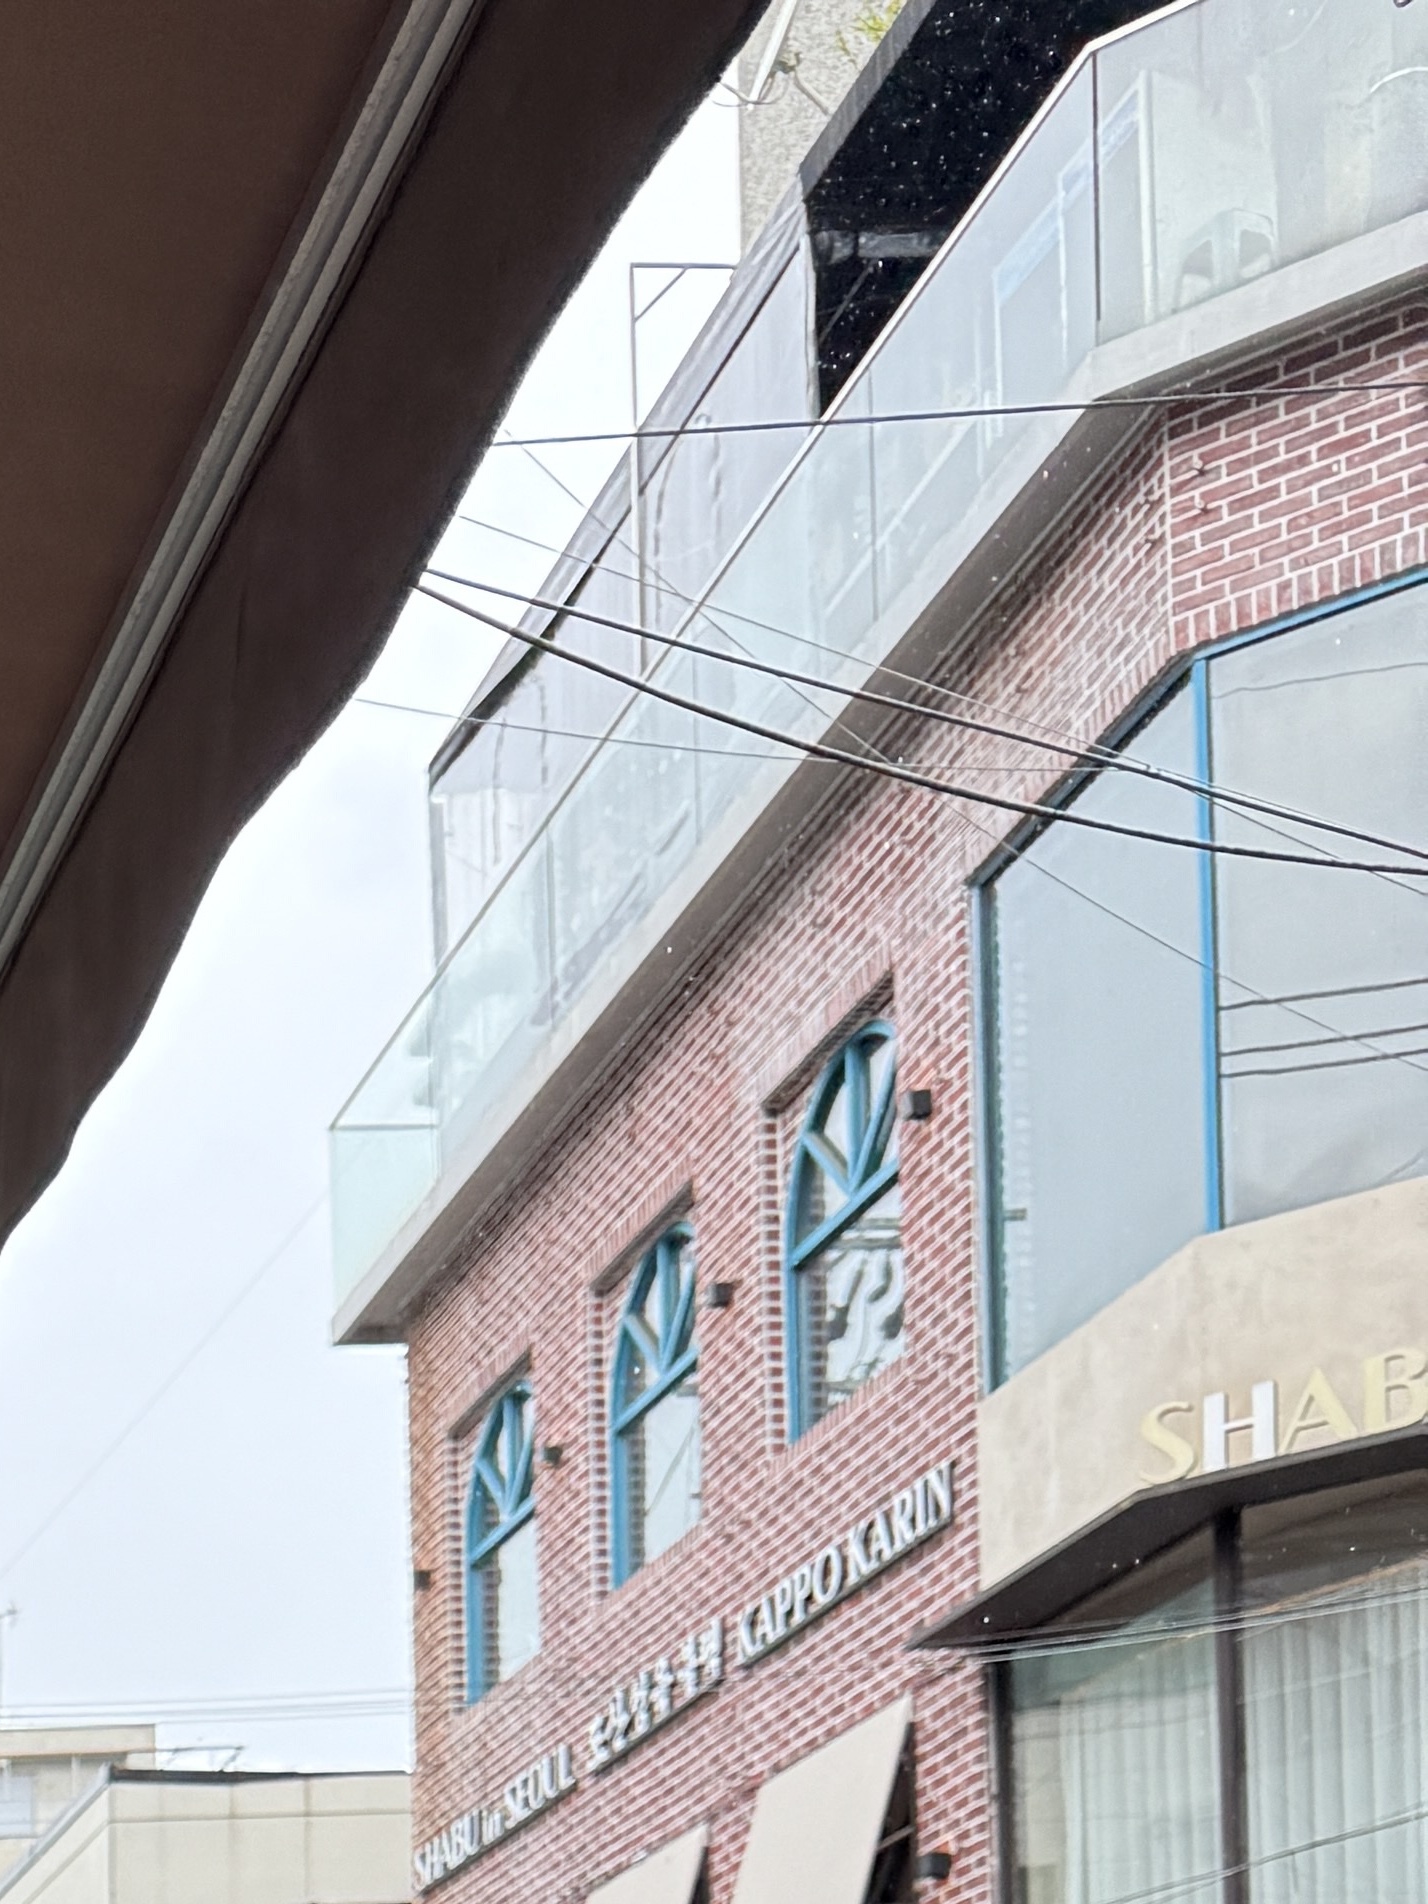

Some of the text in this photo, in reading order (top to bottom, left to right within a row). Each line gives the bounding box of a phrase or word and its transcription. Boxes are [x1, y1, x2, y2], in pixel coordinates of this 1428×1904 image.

[736, 1461, 956, 1665] KAPPO KARIN
[412, 1808, 481, 1892] SHABU
[505, 1742, 577, 1830] SEOUL
